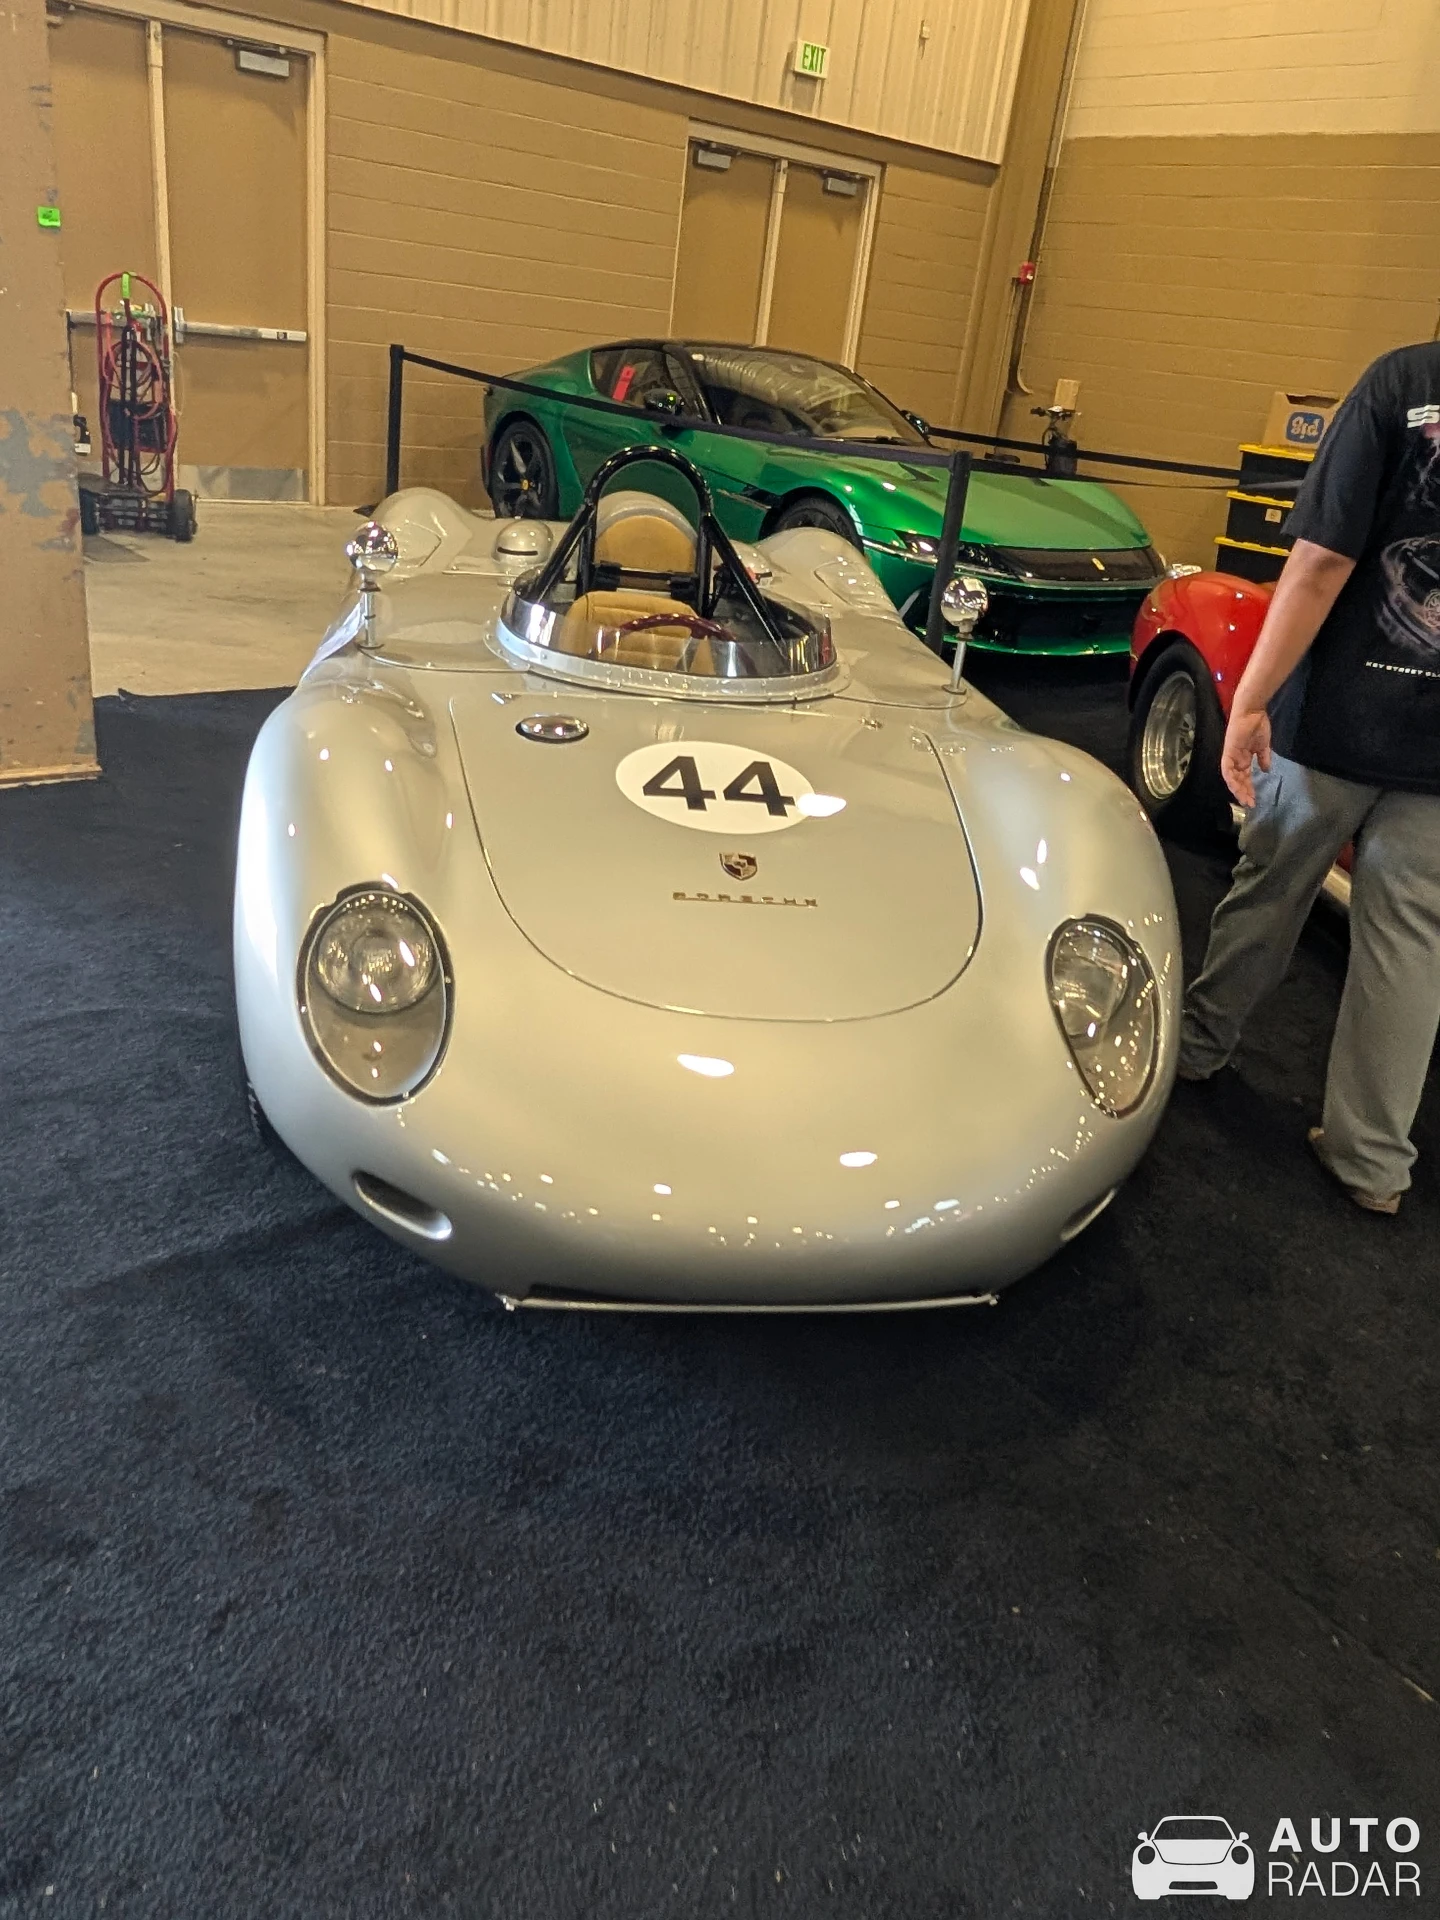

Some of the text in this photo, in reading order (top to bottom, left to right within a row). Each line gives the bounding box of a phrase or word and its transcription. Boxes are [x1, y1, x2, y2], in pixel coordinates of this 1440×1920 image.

[802, 43, 826, 74] EXIT
[642, 755, 796, 817] 44
[672, 892, 818, 907] PORSCHE
